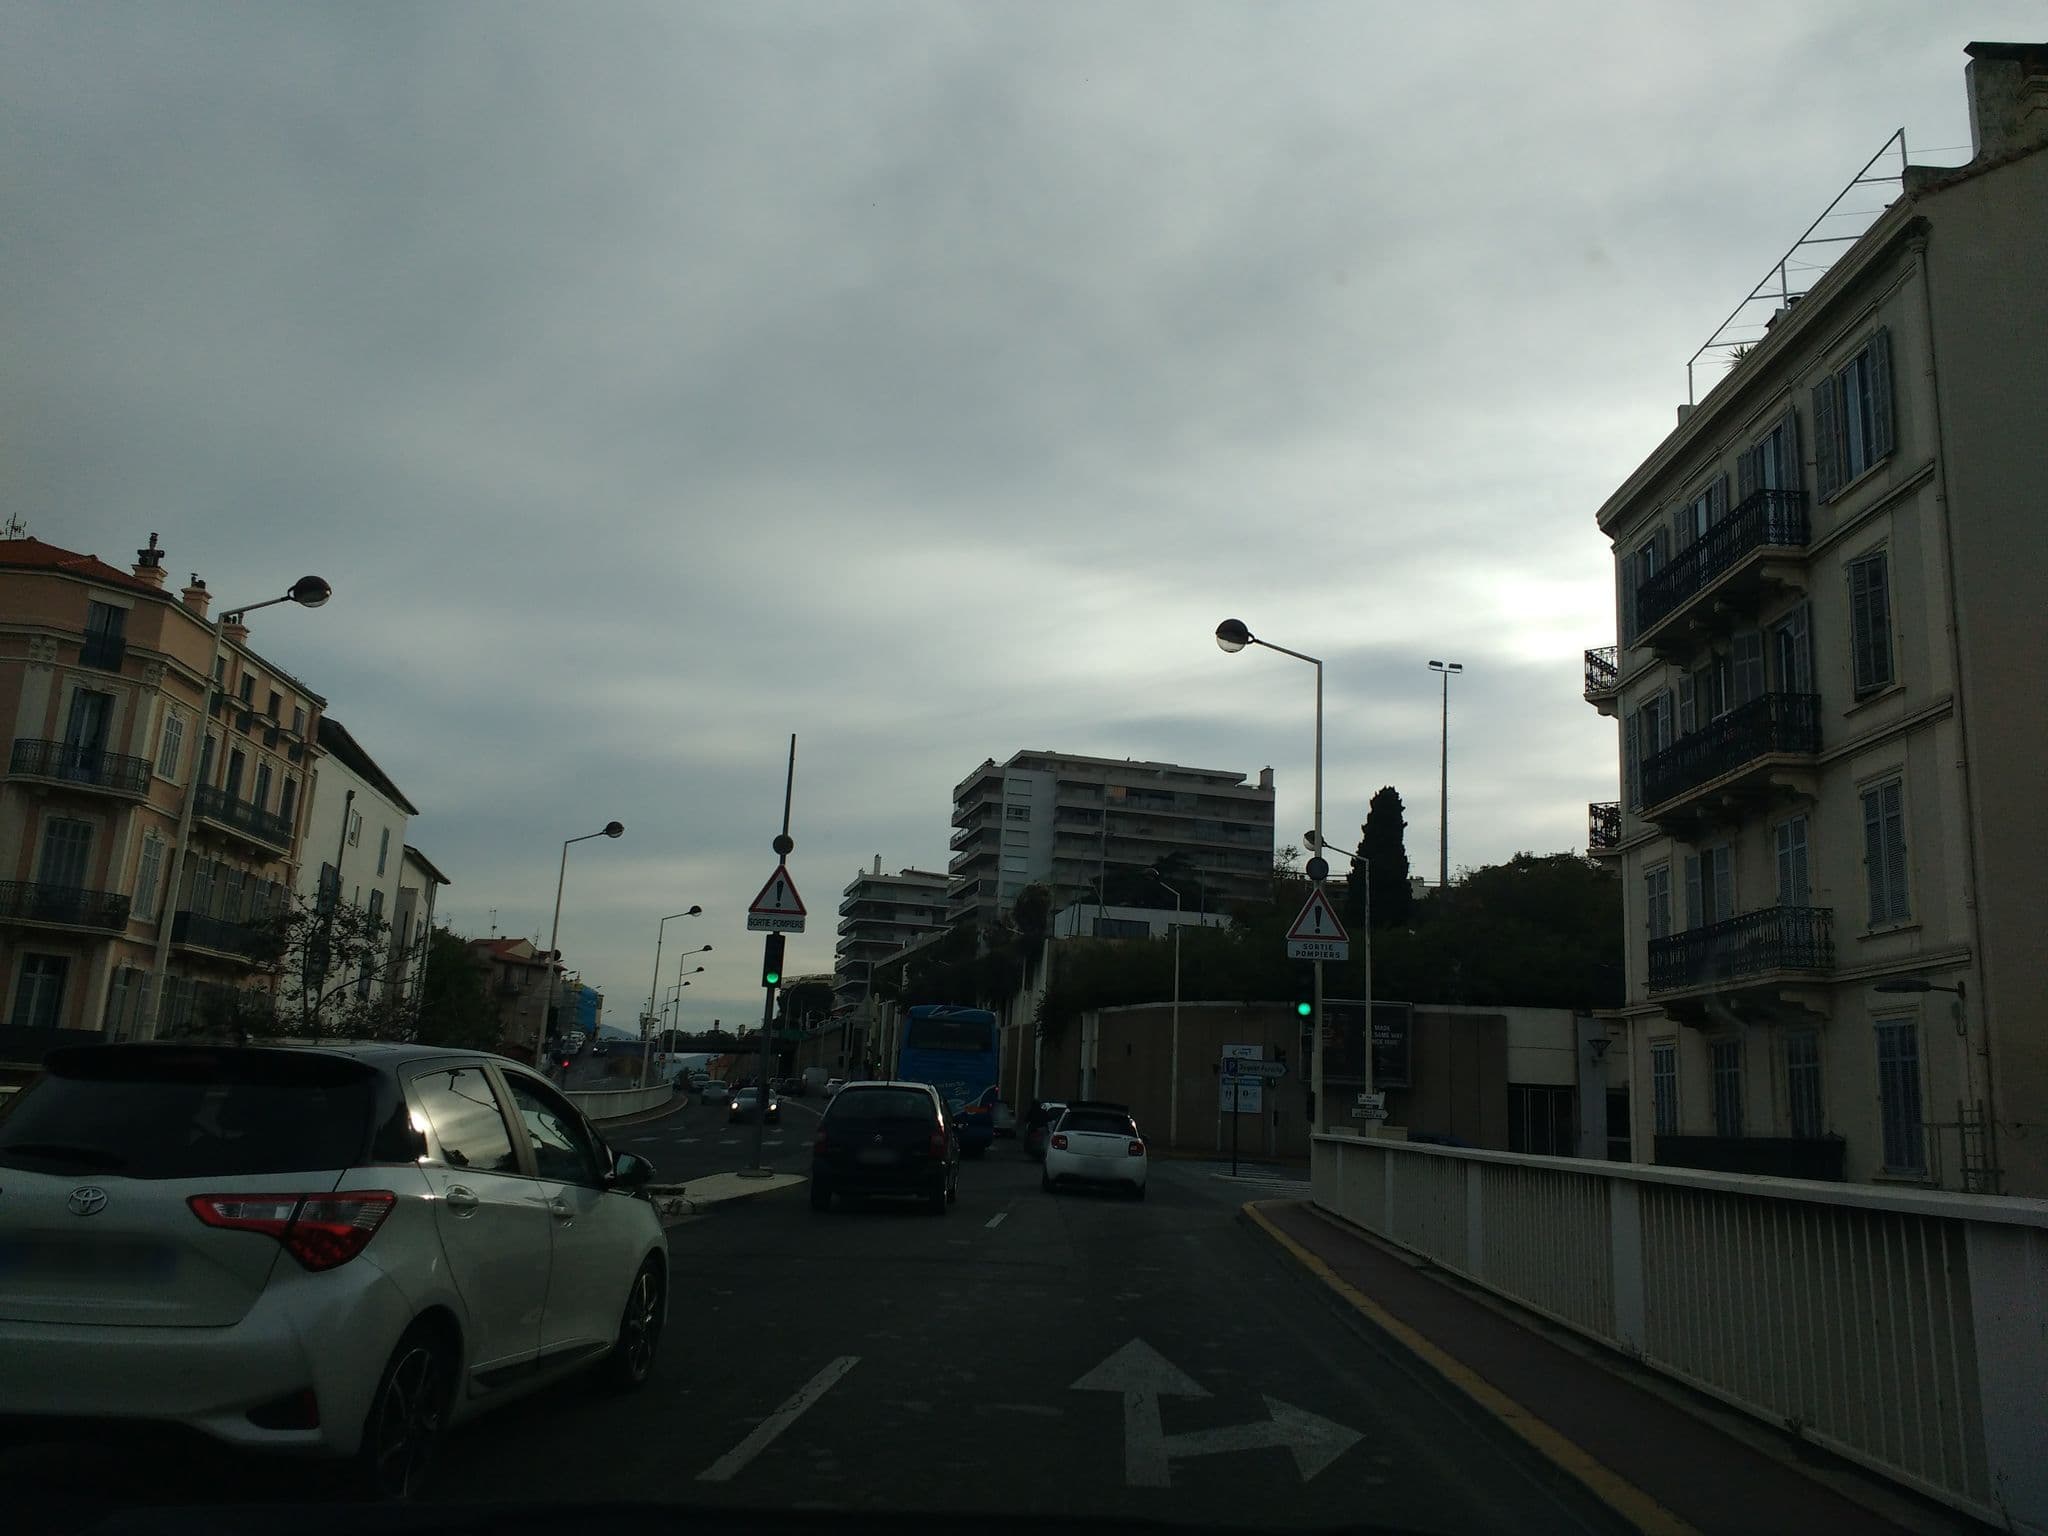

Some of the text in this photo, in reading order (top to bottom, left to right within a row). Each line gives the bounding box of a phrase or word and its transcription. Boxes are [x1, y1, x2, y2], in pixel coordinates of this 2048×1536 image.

[748, 918, 804, 928] SORTIE POMPIERS
[1295, 943, 1341, 959] SORTIE POMPIERS
